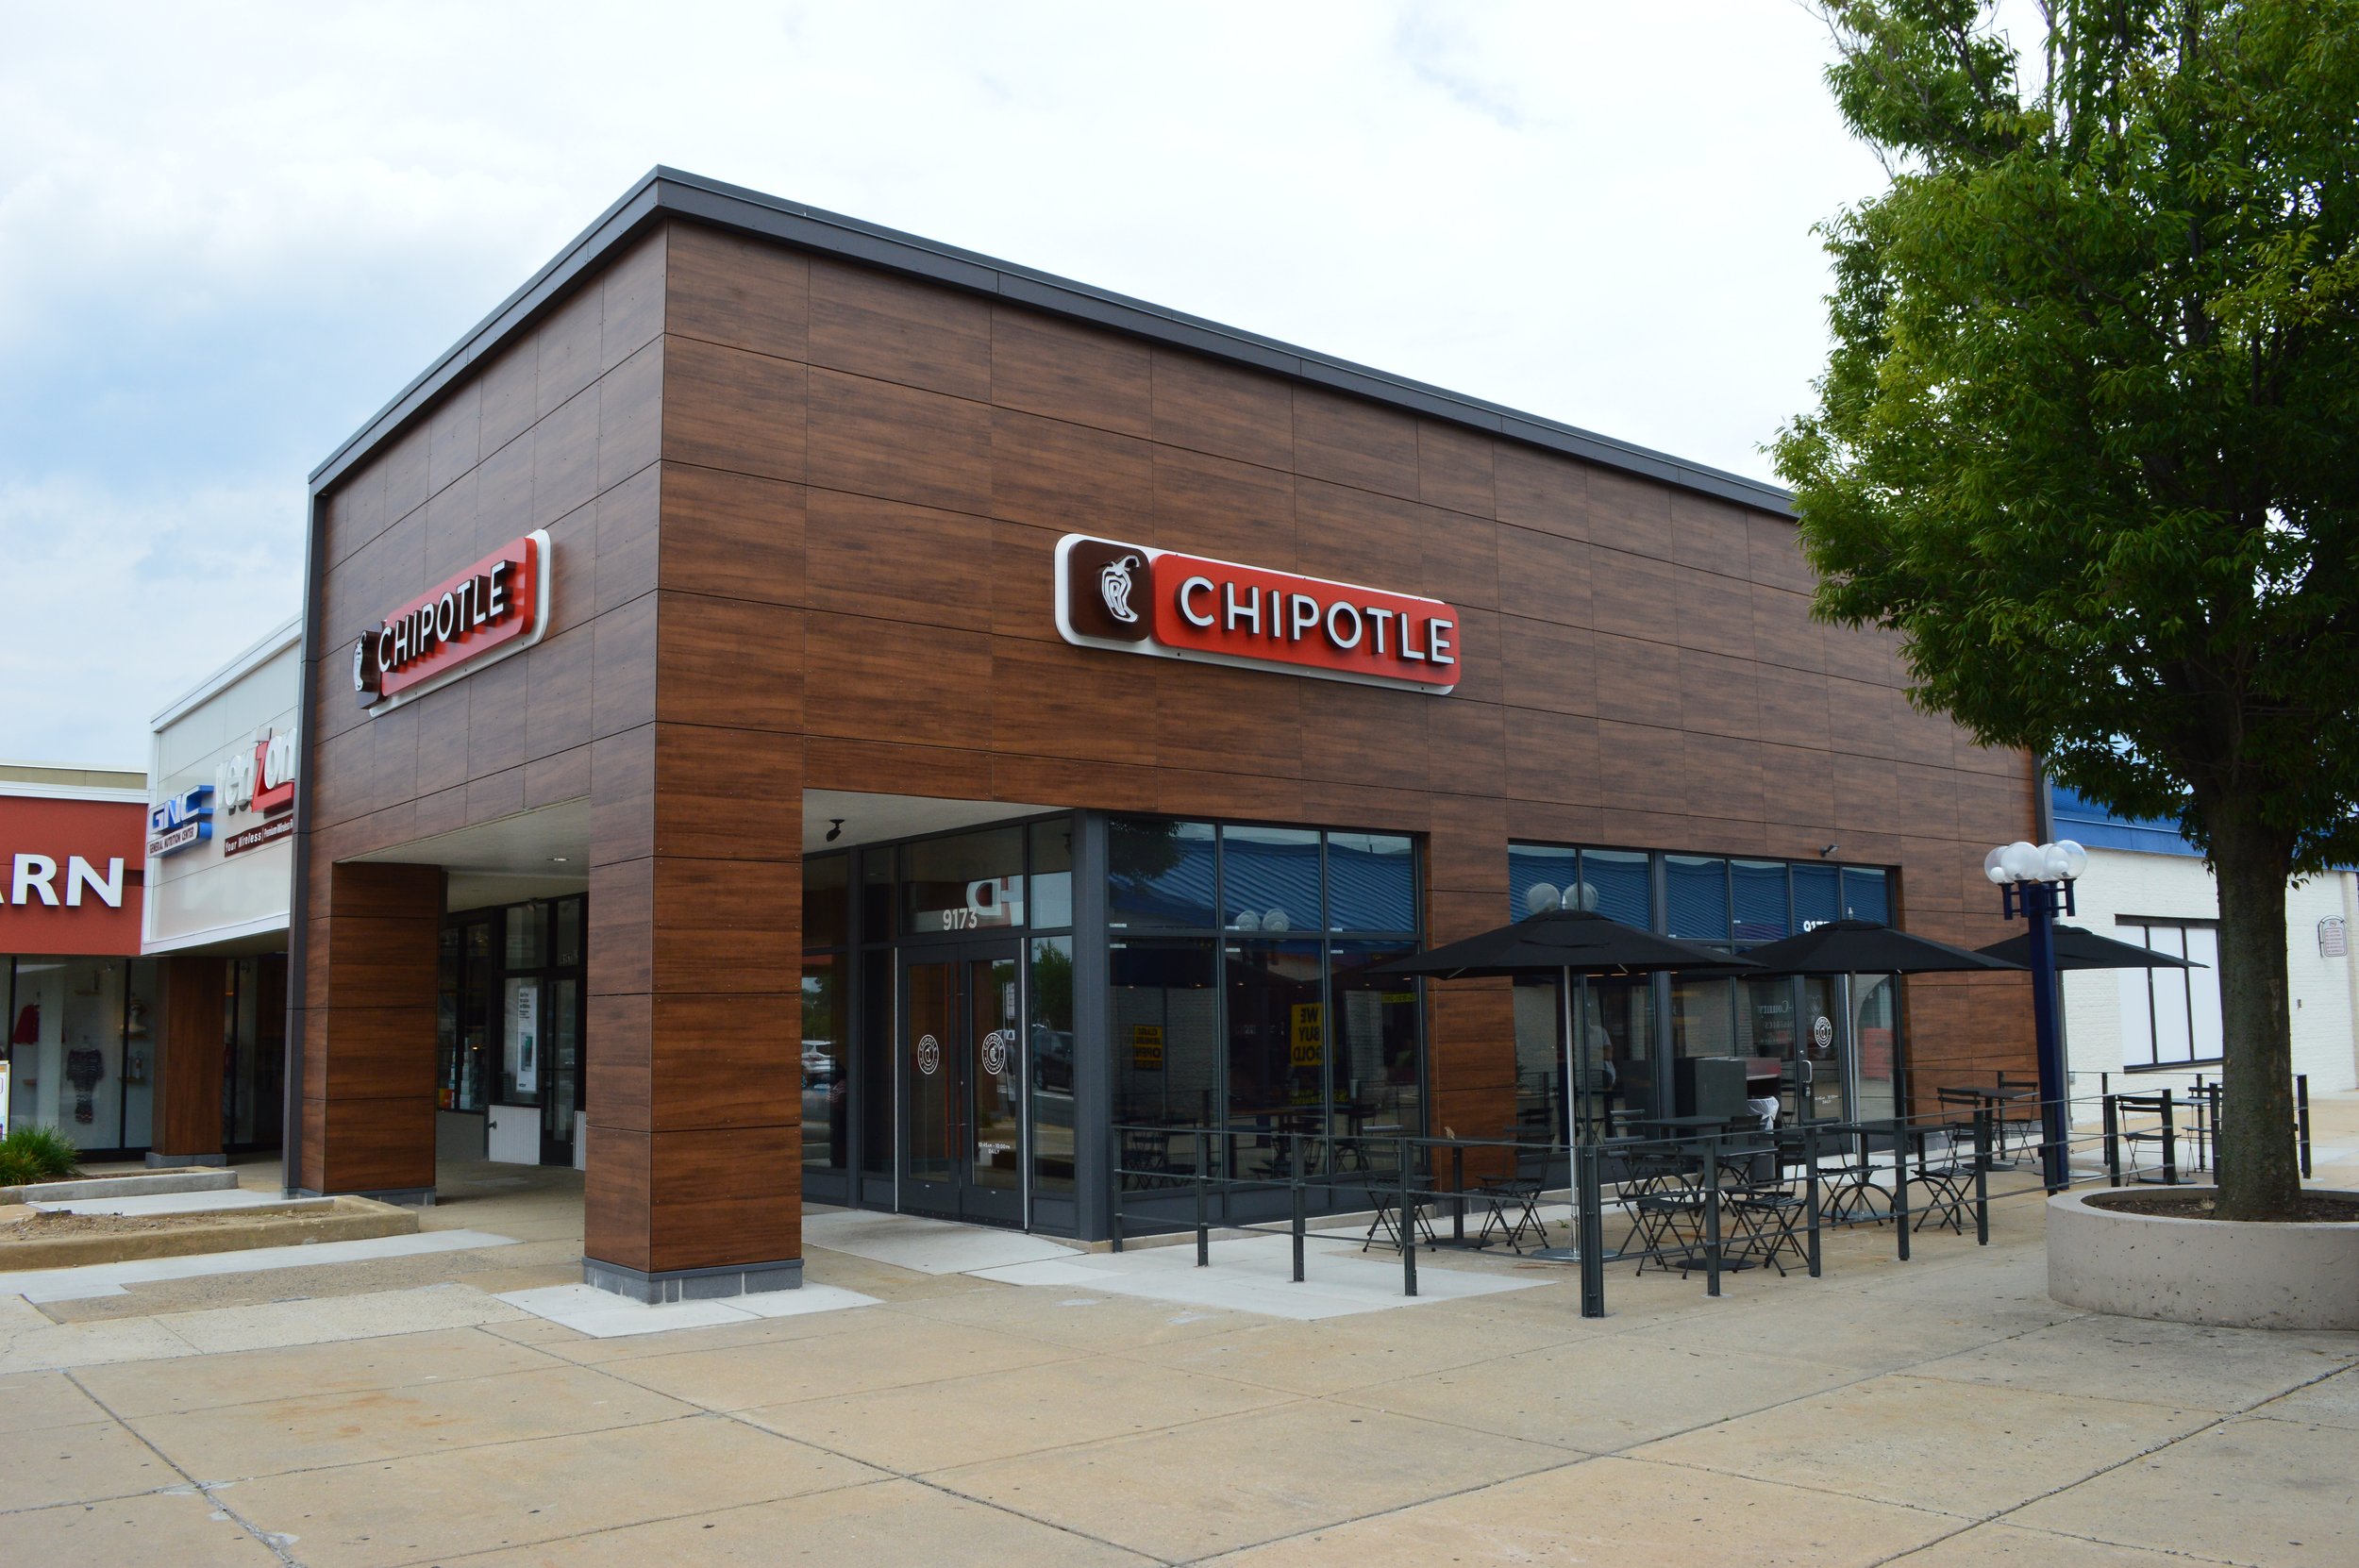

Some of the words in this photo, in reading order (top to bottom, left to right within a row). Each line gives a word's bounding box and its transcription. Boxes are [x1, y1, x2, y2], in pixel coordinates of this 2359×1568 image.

[377, 559, 506, 673] CHIPOTLE
[1177, 575, 1456, 666] CHIPOTLE
[215, 727, 295, 813] verizon
[147, 785, 201, 835] GNC
[149, 842, 164, 854] GENERAL
[164, 833, 181, 848] NUTRITION
[181, 826, 194, 841] CENTER
[238, 831, 262, 848] Wireless
[0, 853, 125, 908] RN
[943, 908, 978, 931] 9173
